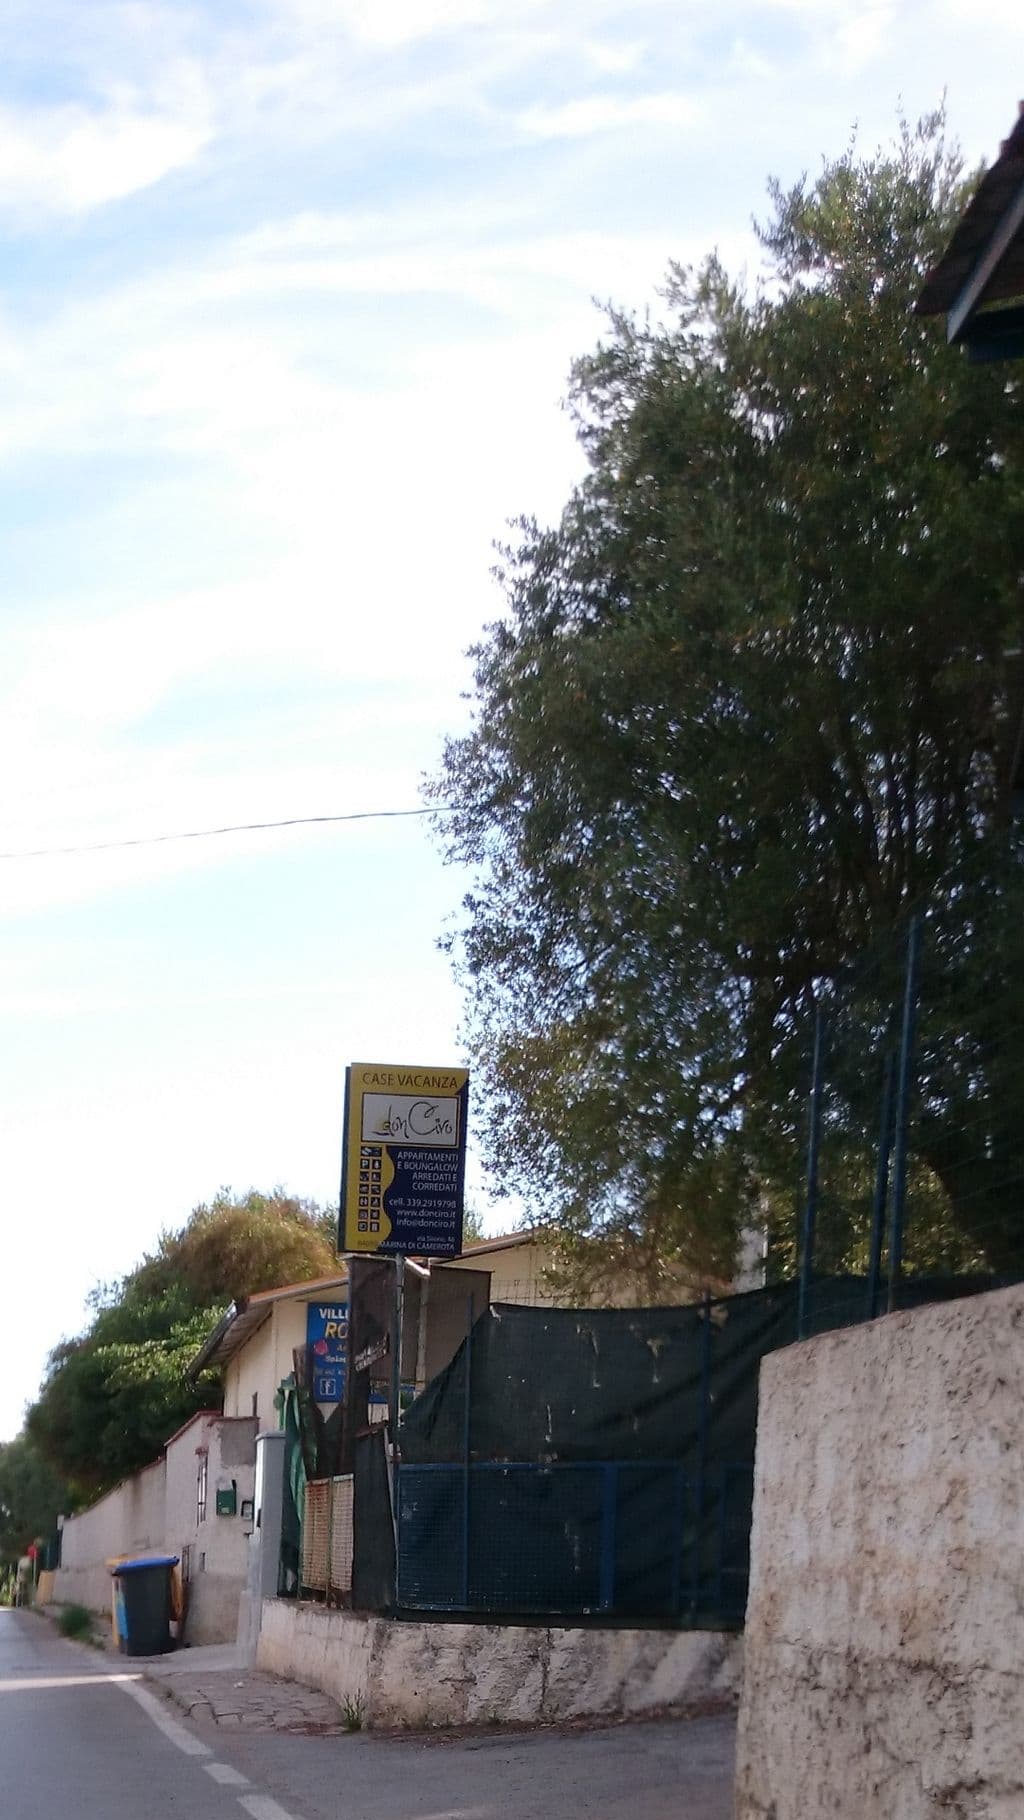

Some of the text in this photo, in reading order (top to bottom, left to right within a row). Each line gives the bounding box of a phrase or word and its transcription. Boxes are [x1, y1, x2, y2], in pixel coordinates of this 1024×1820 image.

[362, 1072, 458, 1088] CASE VACANZA
[408, 1101, 453, 1136] Ciro
[397, 1151, 459, 1162] APPARTAMENTI
[397, 1161, 459, 1172] E BOUNGALOW
[412, 1172, 457, 1182] ARREDATI E
[412, 1182, 457, 1192] CORREDATI
[396, 1209, 456, 1219] www.donciro.it
